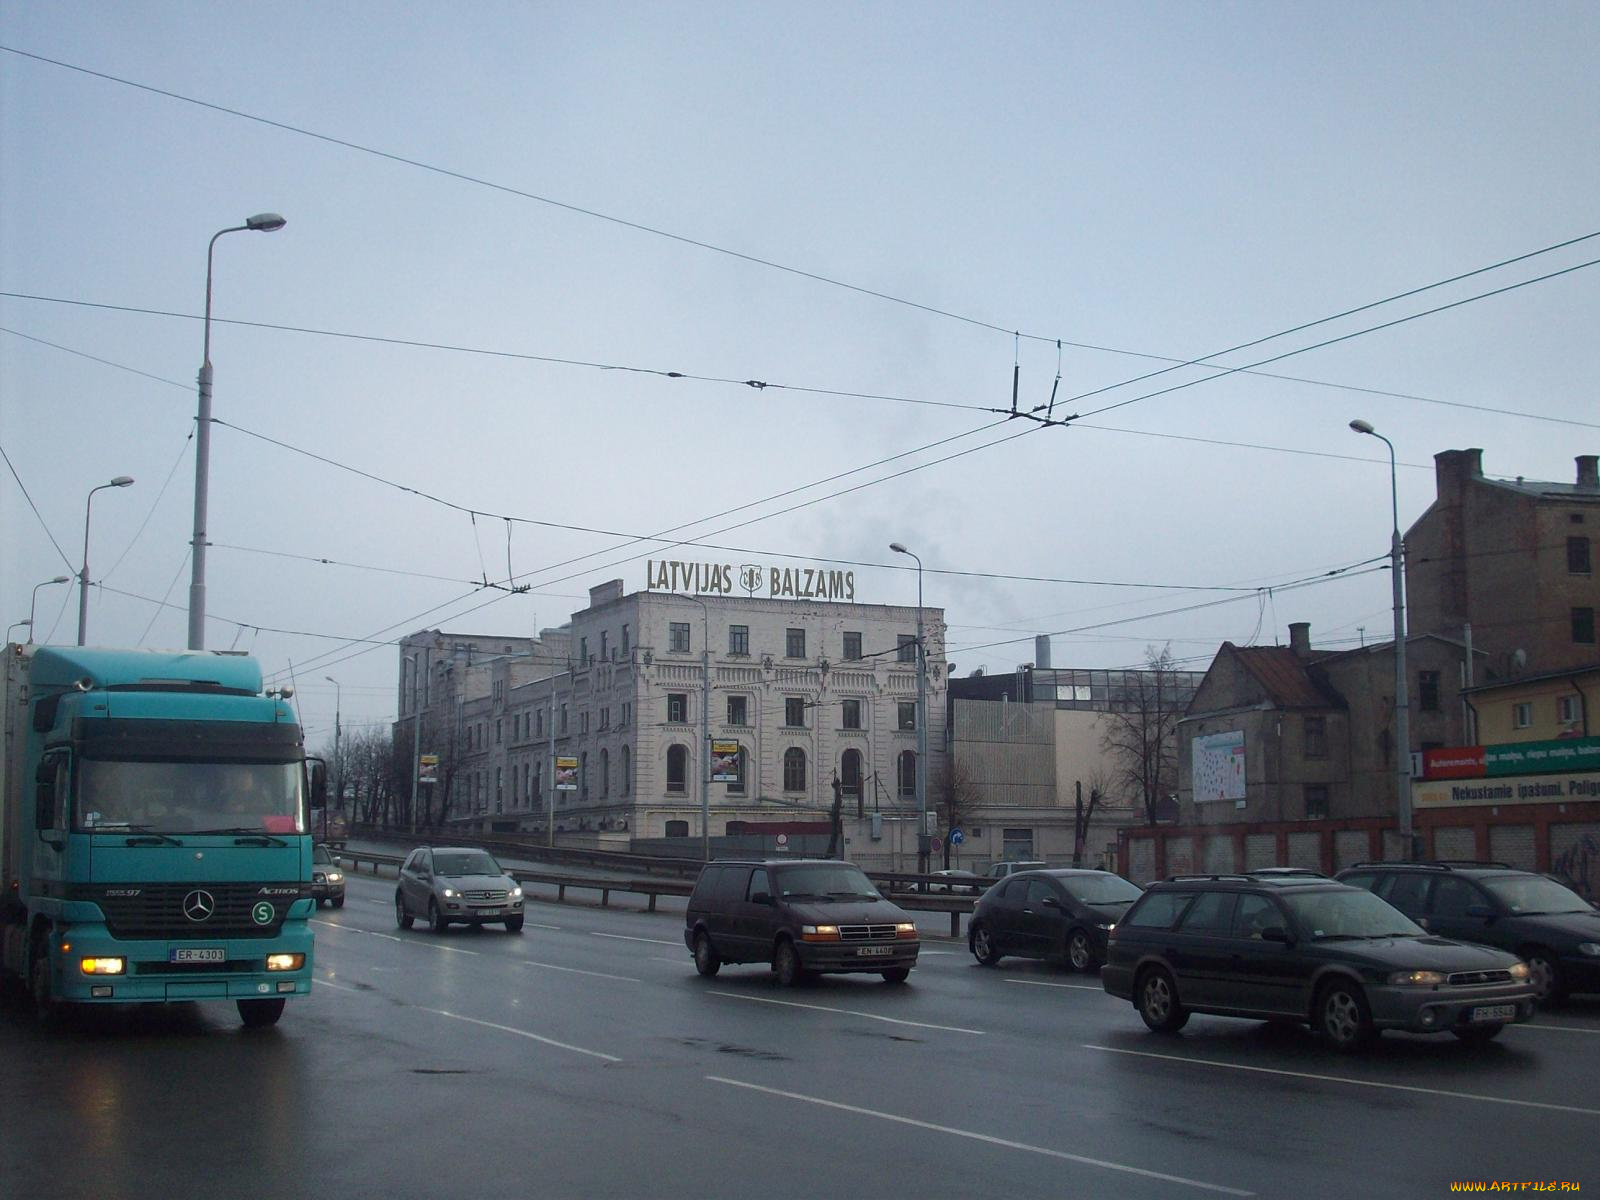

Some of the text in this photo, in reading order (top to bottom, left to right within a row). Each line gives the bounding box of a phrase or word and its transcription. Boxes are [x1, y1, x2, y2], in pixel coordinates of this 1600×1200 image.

[647, 559, 733, 593] LATVIJAS
[770, 567, 855, 599] BALZAMS
[1452, 784, 1513, 800] Nekustamie
[258, 907, 269, 921] S
[178, 950, 224, 960] ER-4303
